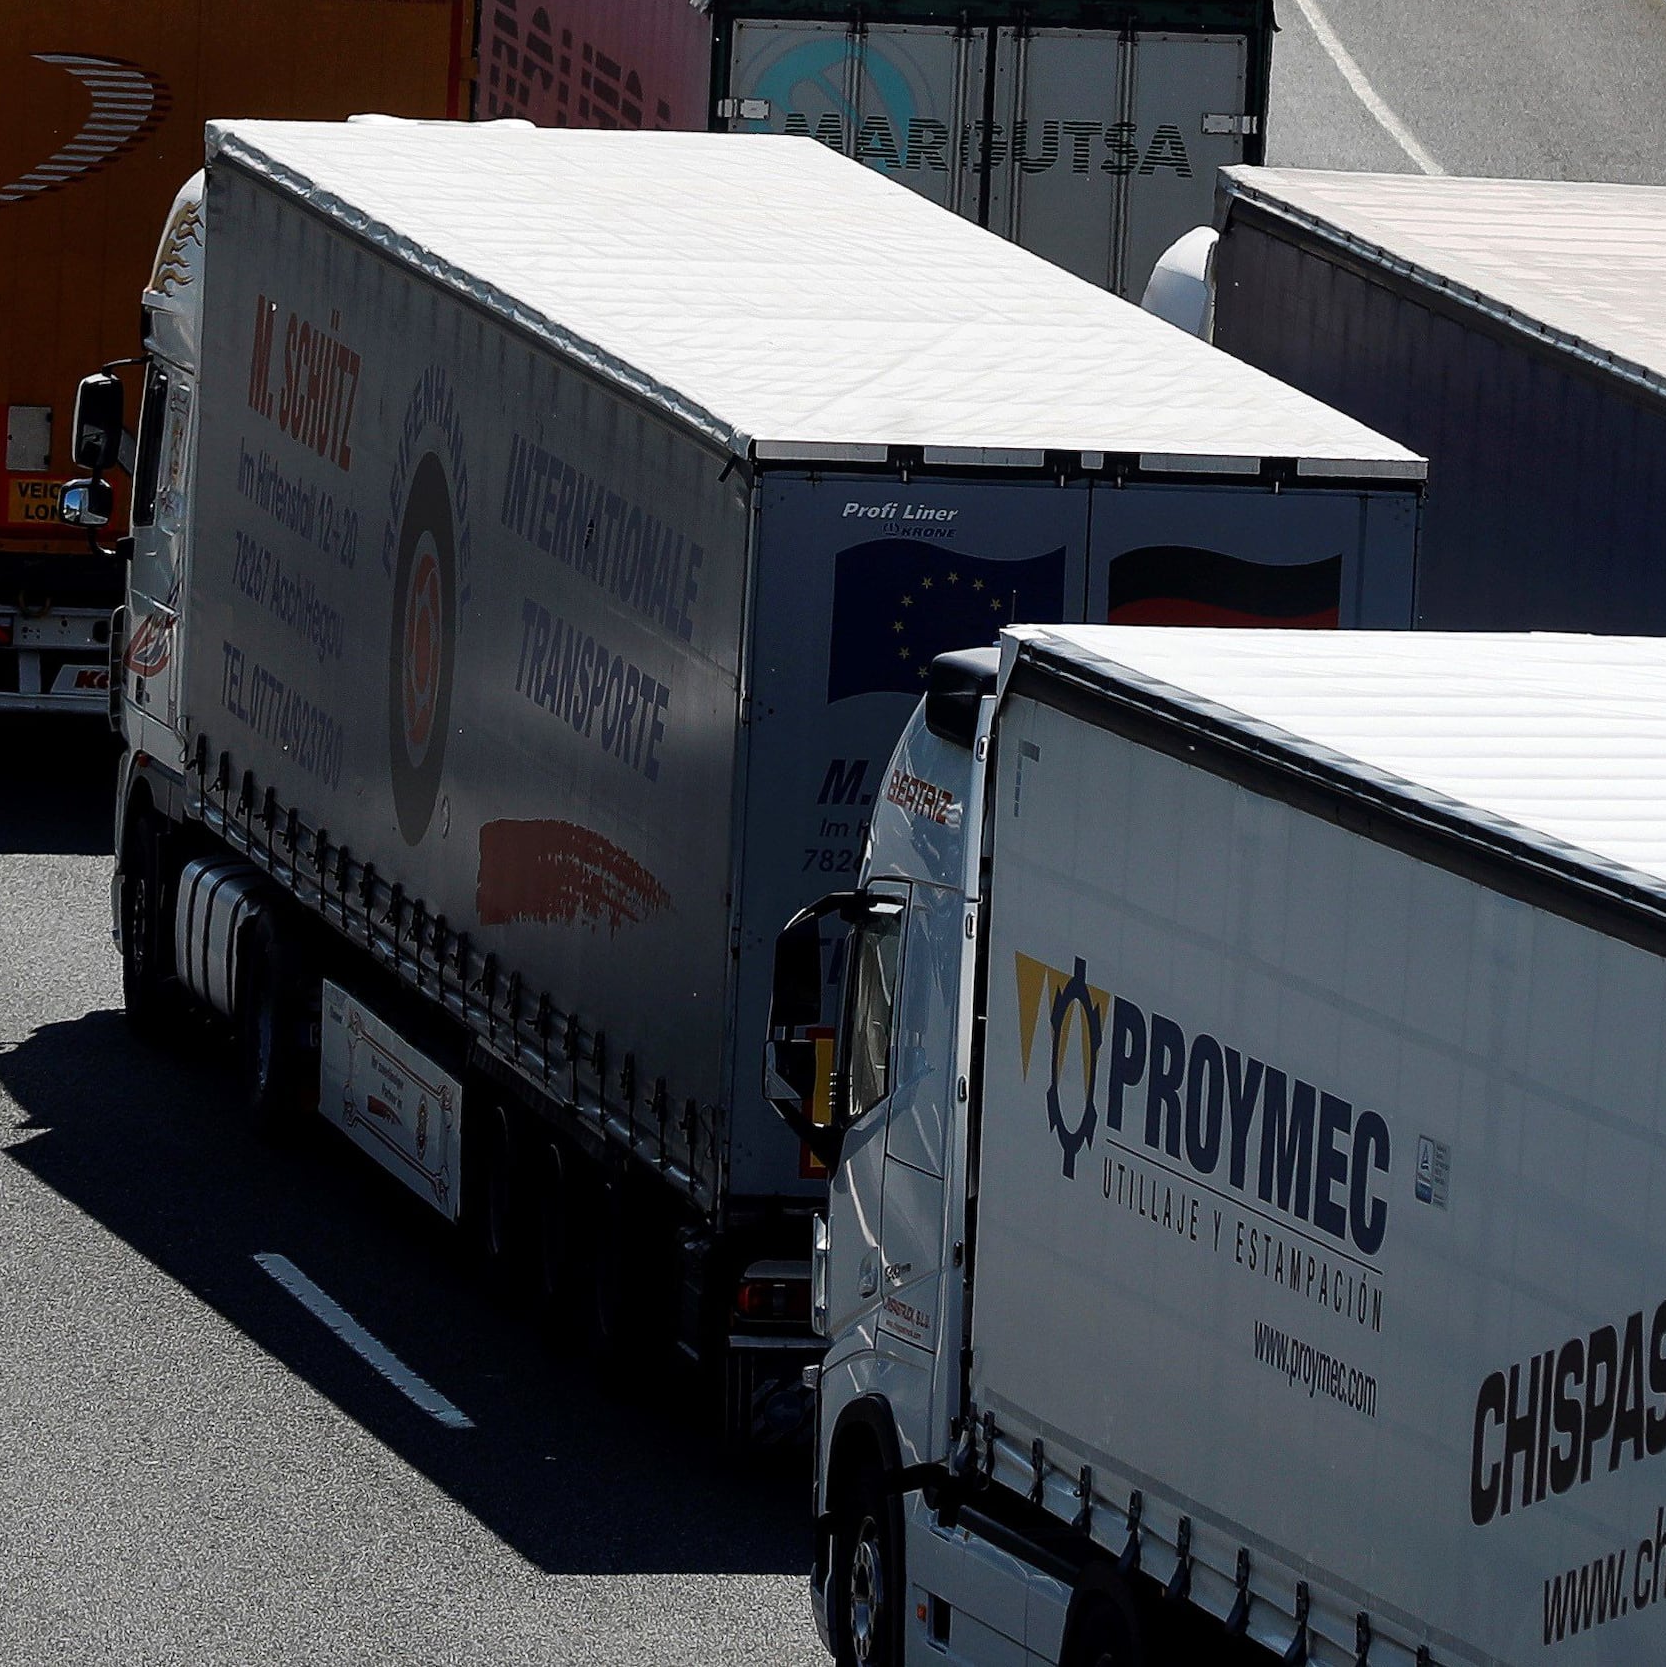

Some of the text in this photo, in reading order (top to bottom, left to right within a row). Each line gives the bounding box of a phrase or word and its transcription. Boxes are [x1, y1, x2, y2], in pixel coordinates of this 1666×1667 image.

[279, 310, 361, 473] SCHÜTZ
[501, 433, 704, 643] INTERNATIONALE
[842, 501, 960, 522] Profi Liner
[902, 526, 957, 538] KRONE
[515, 597, 670, 783] TRANSPORTE
[817, 758, 873, 806] M.
[820, 817, 849, 838] Im
[887, 769, 955, 826] BEATRIZ
[1107, 994, 1391, 1257] PROYMEC
[1103, 1156, 1382, 1333] UTILLAJE Y ESTAMPACIÓN
[1254, 1320, 1378, 1418] www.proymec.com
